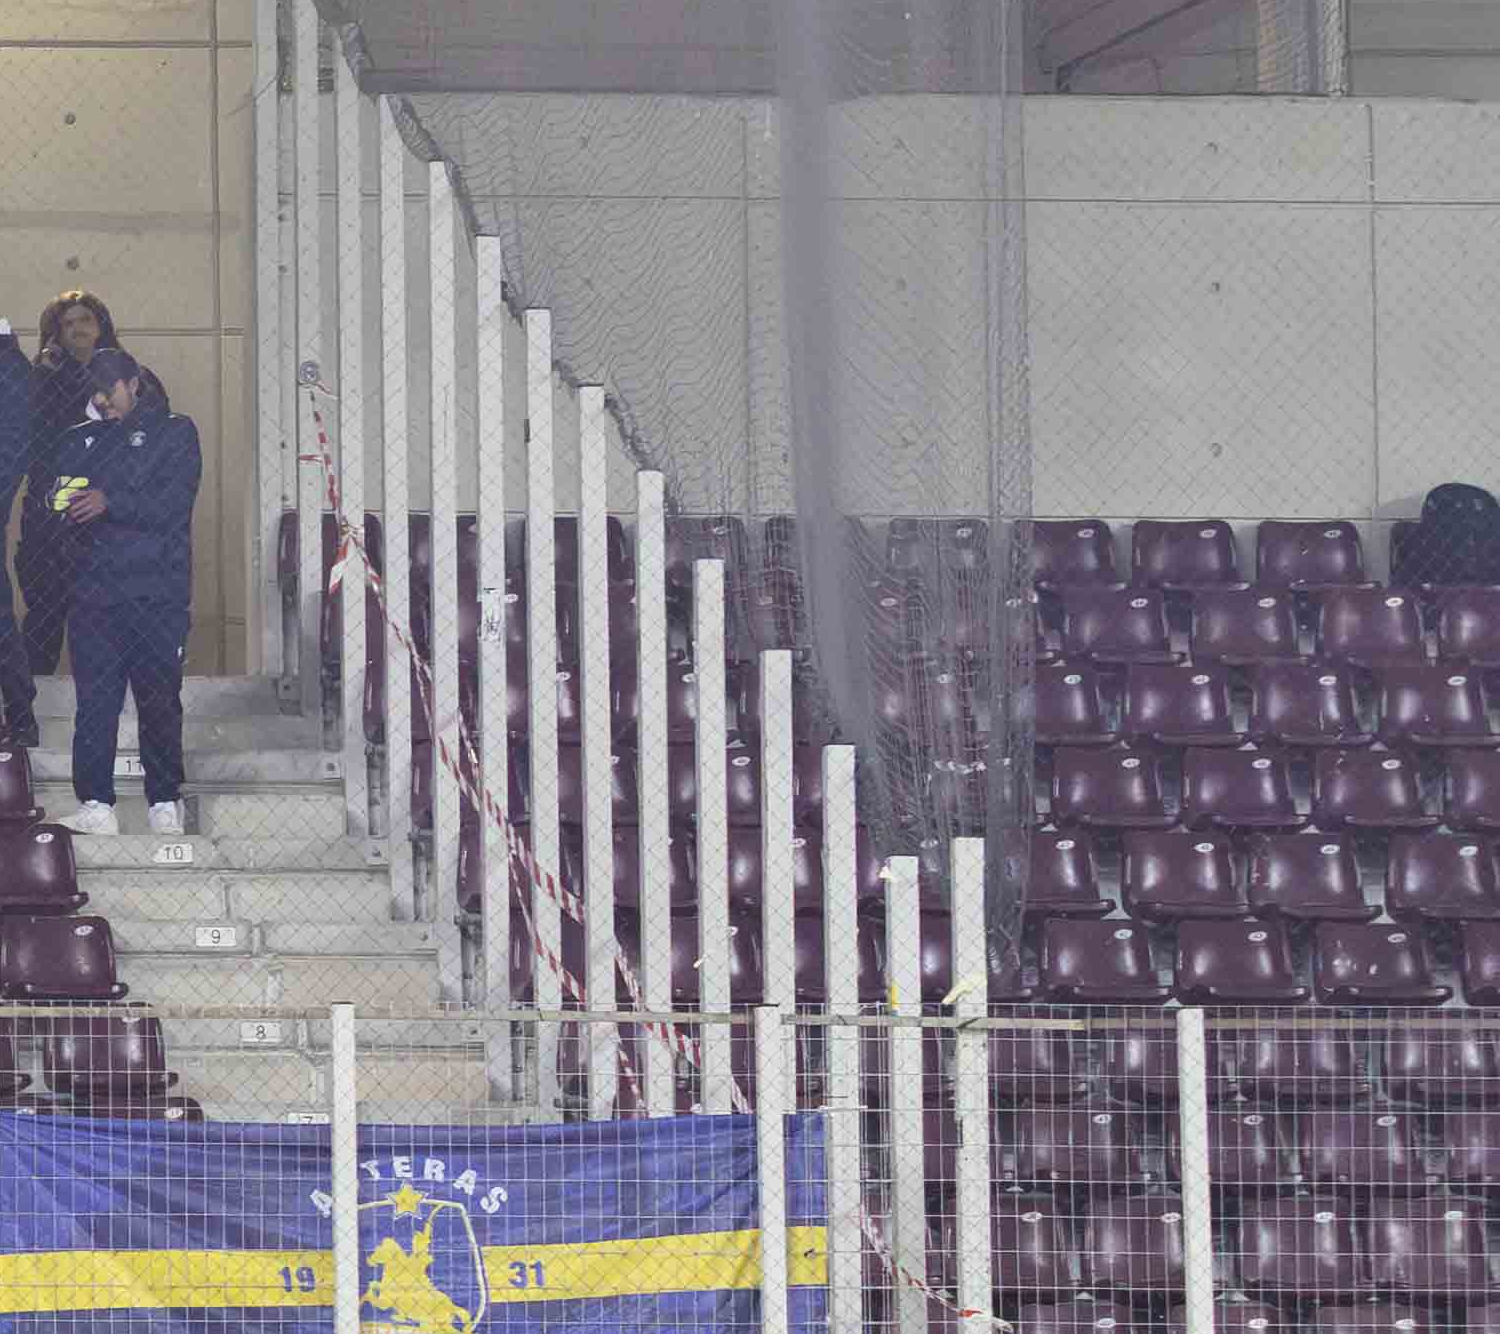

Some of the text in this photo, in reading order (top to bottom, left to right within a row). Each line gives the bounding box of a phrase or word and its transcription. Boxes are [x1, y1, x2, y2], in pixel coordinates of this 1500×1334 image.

[163, 845, 184, 861] 10
[211, 929, 221, 944] 9
[255, 1025, 266, 1040] 8
[309, 1155, 509, 1218] ATERAS
[278, 1261, 546, 1293] 19 31
